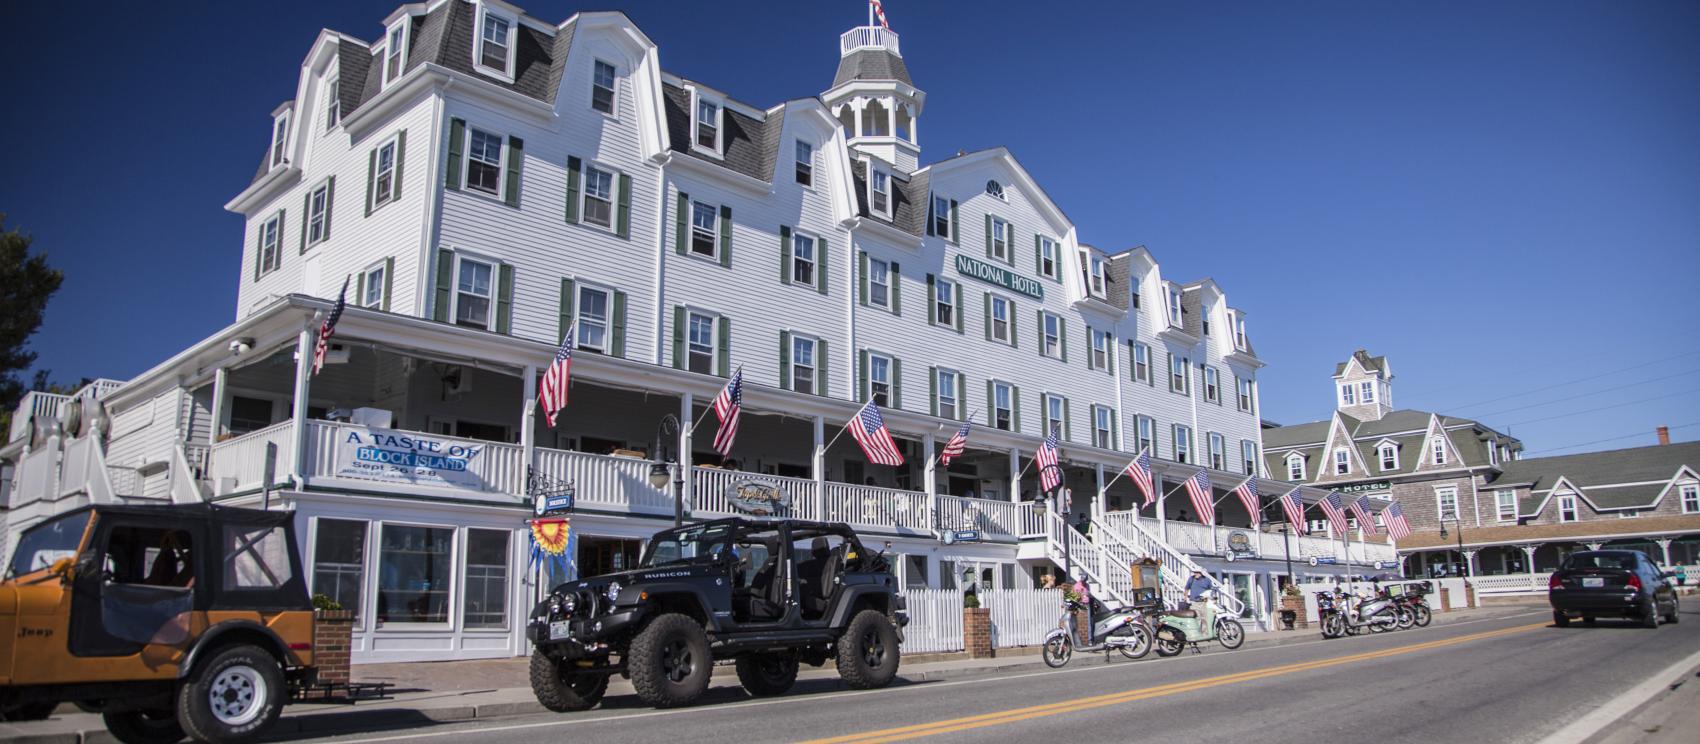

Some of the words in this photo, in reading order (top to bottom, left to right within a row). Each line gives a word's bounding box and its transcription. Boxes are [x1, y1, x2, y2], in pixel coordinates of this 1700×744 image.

[958, 255, 1007, 286] NATIONAL
[1011, 274, 1041, 297] HOTEL
[347, 432, 362, 444] A
[370, 434, 441, 453] TASTE
[352, 460, 385, 472] Sept
[360, 448, 410, 465] BLOCK
[414, 454, 466, 471] ISLAND
[1344, 483, 1387, 492] HOTEL
[644, 571, 691, 579] RUBICON
